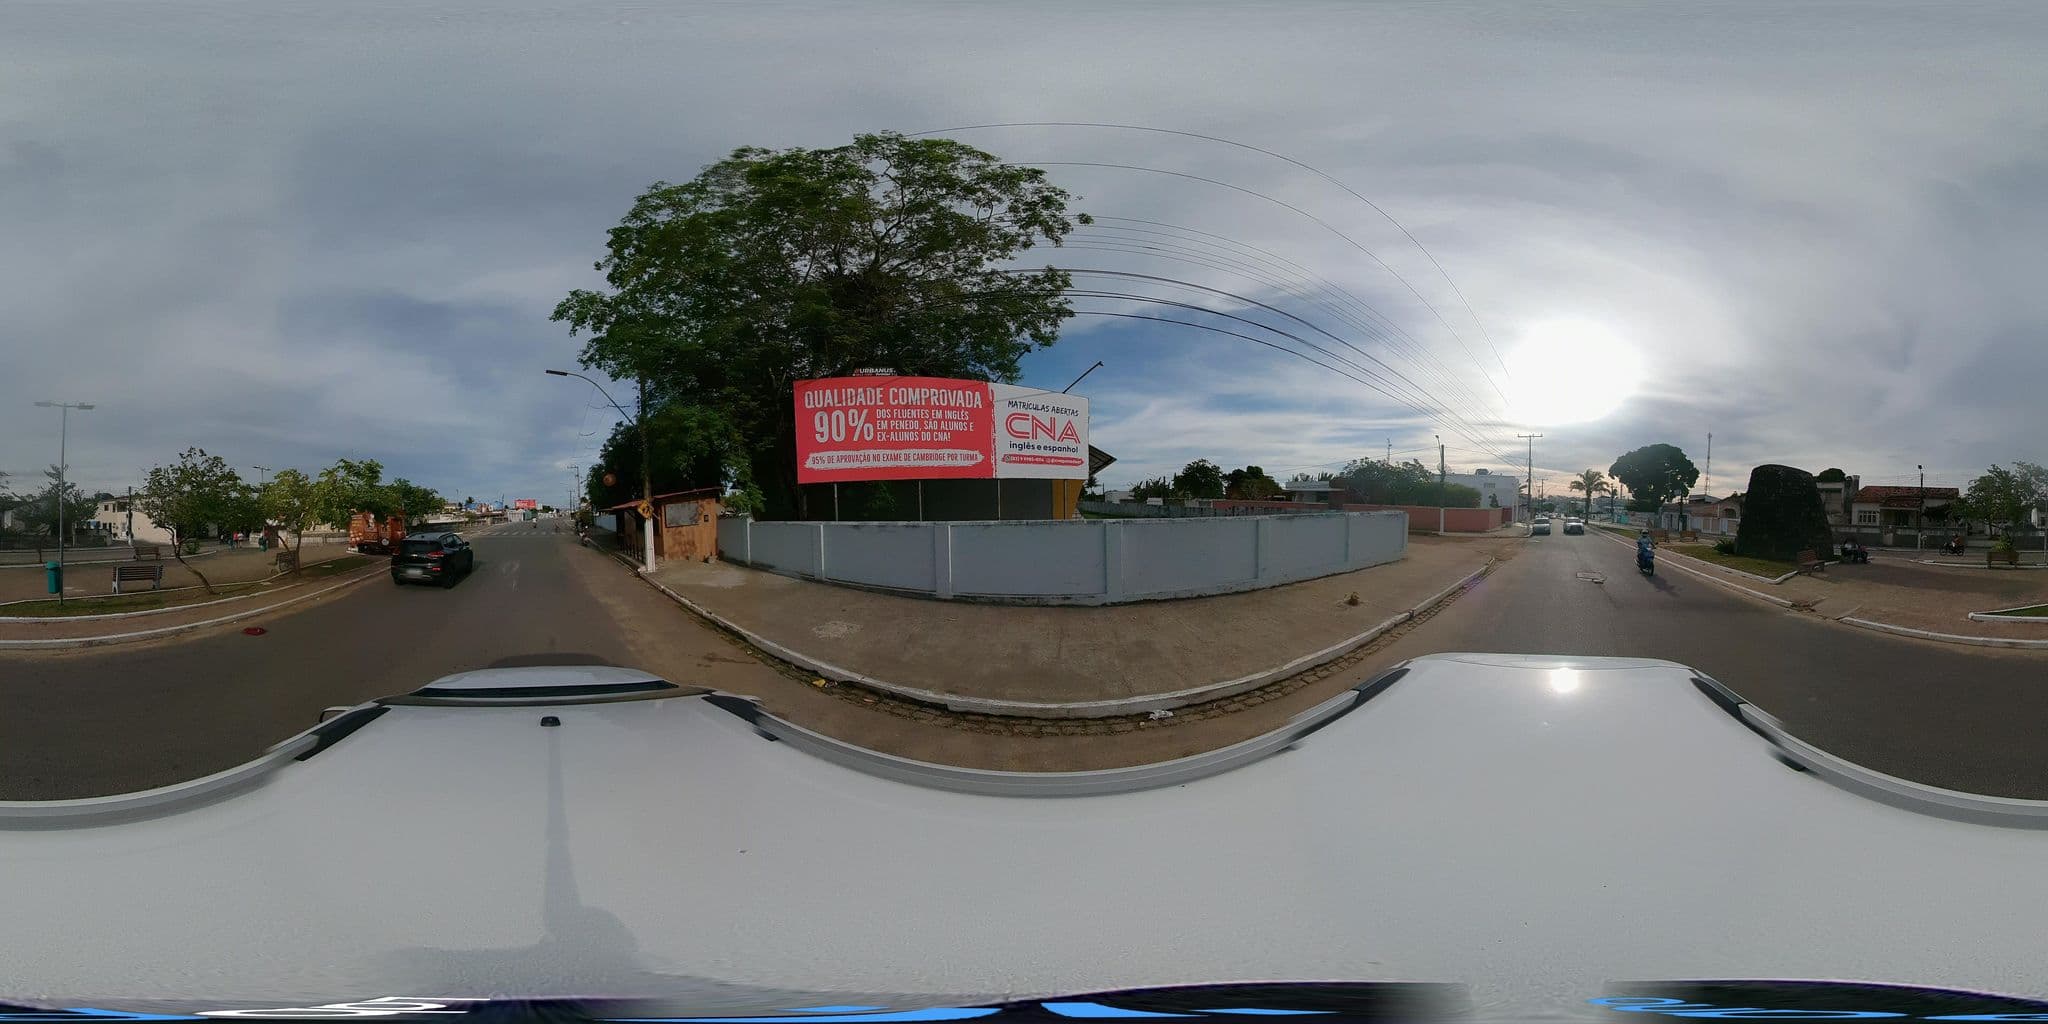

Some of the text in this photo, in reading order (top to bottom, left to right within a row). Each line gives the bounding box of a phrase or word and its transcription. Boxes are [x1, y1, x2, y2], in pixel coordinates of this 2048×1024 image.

[804, 387, 983, 409] QUALIDADE COMPROVADA
[876, 409, 969, 420] DOS FLUENTES EM INGLÊS
[1007, 400, 1079, 417] MATRÍCULAS ABERTAS
[814, 408, 874, 443] 90%
[877, 419, 974, 431] EM PENEDO, SÃO ALUNOS E
[1005, 412, 1081, 445] CNA
[877, 431, 951, 442] EX-ALUNOS DO CNA!
[1009, 440, 1036, 451] inglês
[1043, 444, 1079, 454] espanhol
[811, 453, 978, 465] 95% DE APROVAÇÃO NO EXAME DE CAMBRIDGE POR TURMA
